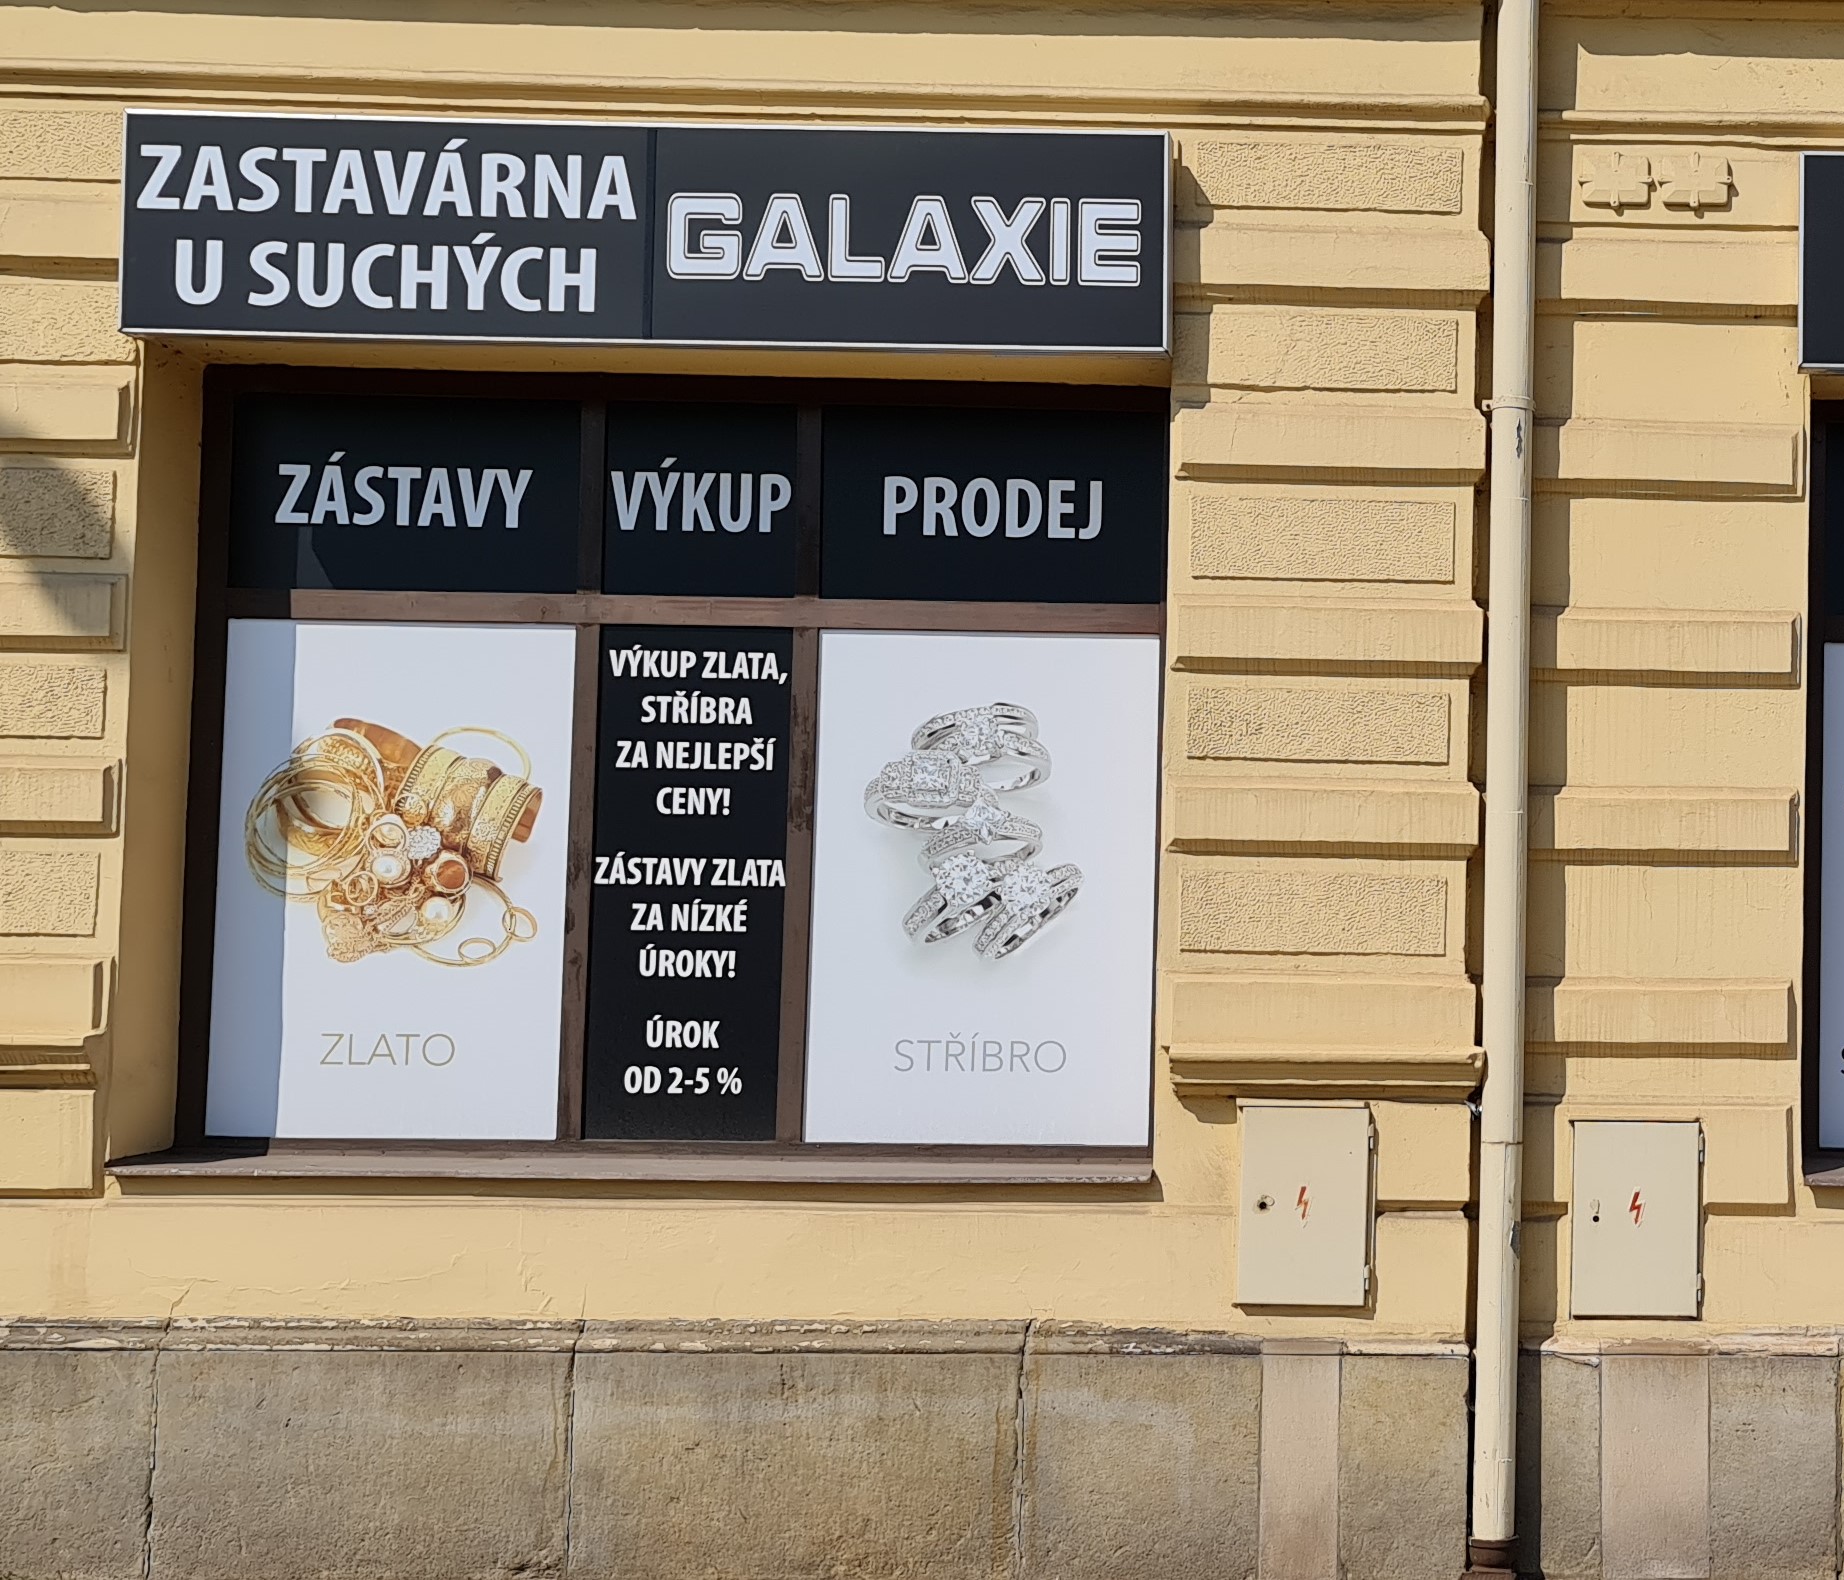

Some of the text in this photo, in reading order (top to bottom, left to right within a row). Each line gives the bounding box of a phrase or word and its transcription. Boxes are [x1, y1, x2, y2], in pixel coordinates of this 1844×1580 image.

[137, 139, 636, 219] ZASTAVÁRNA
[667, 193, 1141, 286] GALAXIE
[176, 233, 596, 312] U SUCHÝCH
[275, 452, 533, 528] ZÁSTAVY
[611, 458, 791, 532] VÝKUP
[884, 476, 1102, 539] PRODEJ
[610, 645, 787, 684] VÝKUP ZLATA,
[641, 691, 752, 724] STŘÍBRA
[616, 738, 776, 770] ZA NEJLEPŠÍ
[657, 787, 730, 815] CENY!
[594, 852, 786, 886] ZÁSTAVY ZLATA
[631, 899, 747, 932] ZA NÍZKÉ
[640, 944, 736, 978] ÚROKY!
[647, 1015, 719, 1048] ÚROK
[320, 1034, 455, 1066] ZLATO
[895, 1032, 1066, 1072] STŘÍBRO
[624, 1066, 742, 1094] OD 2-5 %
